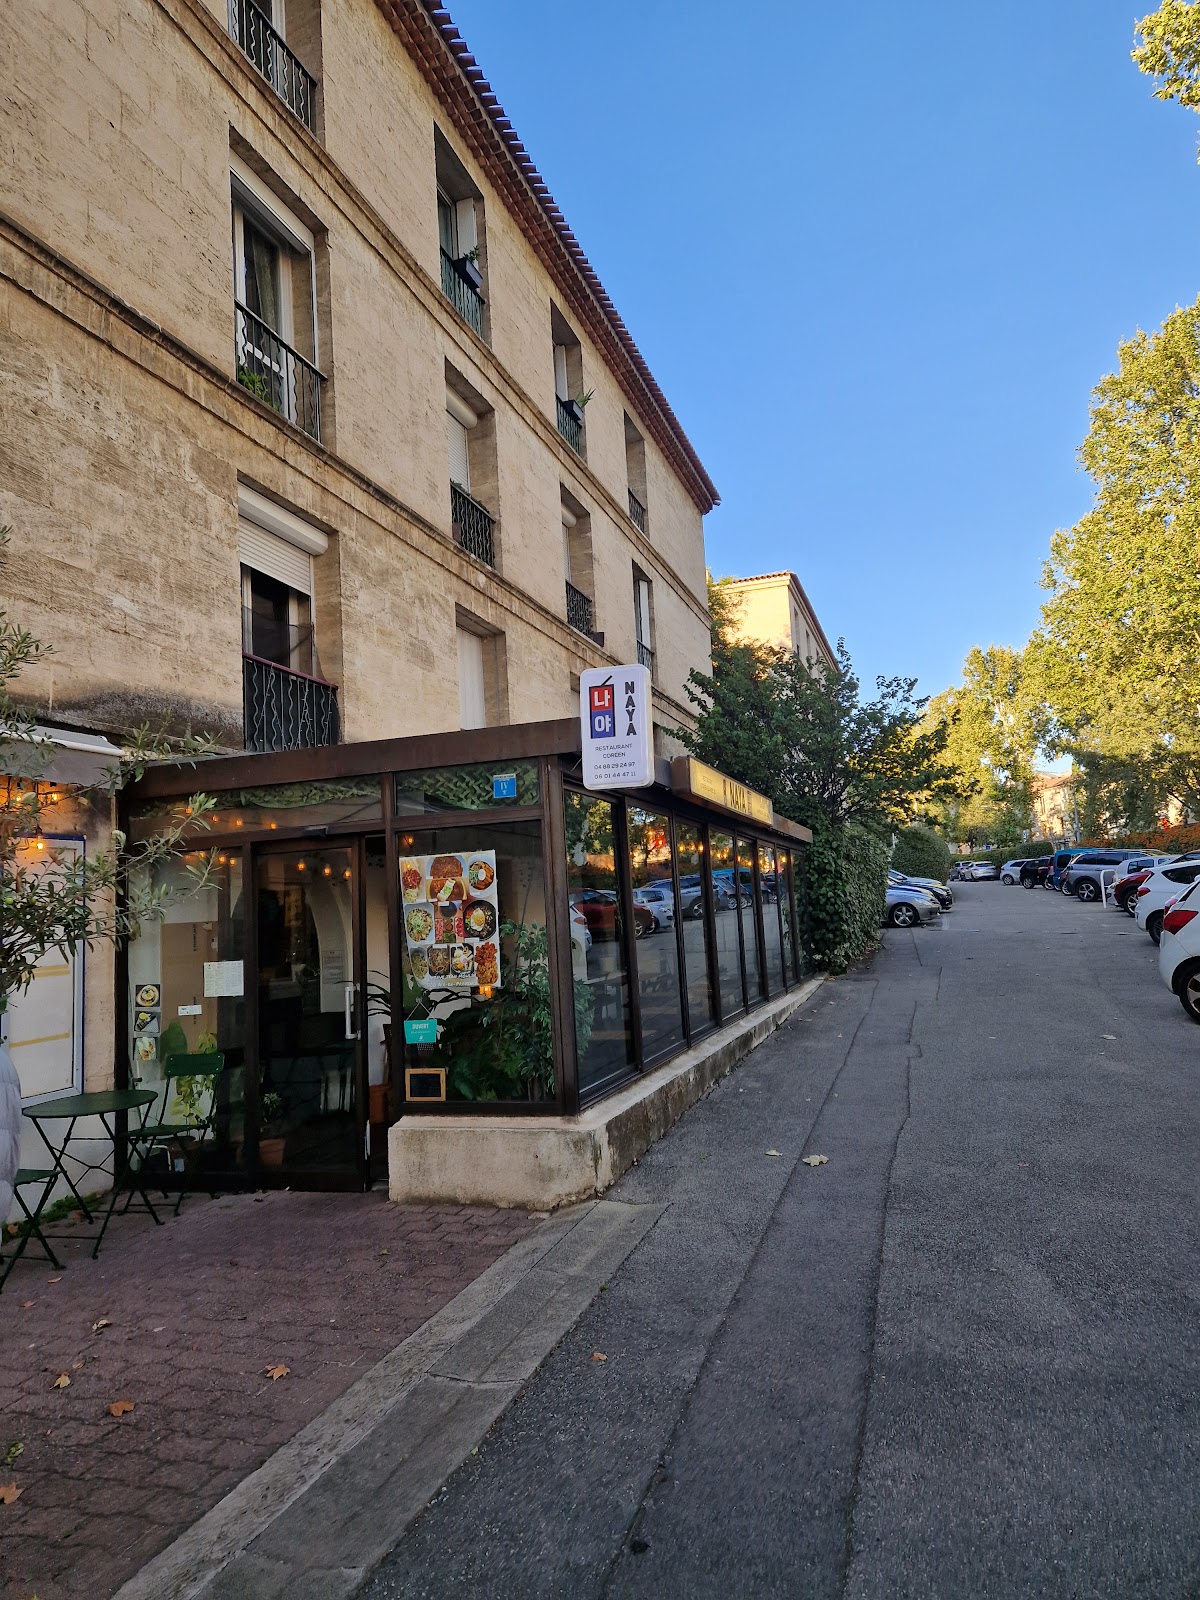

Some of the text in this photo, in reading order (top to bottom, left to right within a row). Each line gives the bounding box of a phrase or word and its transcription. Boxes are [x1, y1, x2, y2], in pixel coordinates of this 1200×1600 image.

[594, 690, 611, 732] 나야
[625, 681, 637, 736] NAYA
[595, 743, 632, 752] RESTAURANT
[729, 780, 747, 813] NAYA
